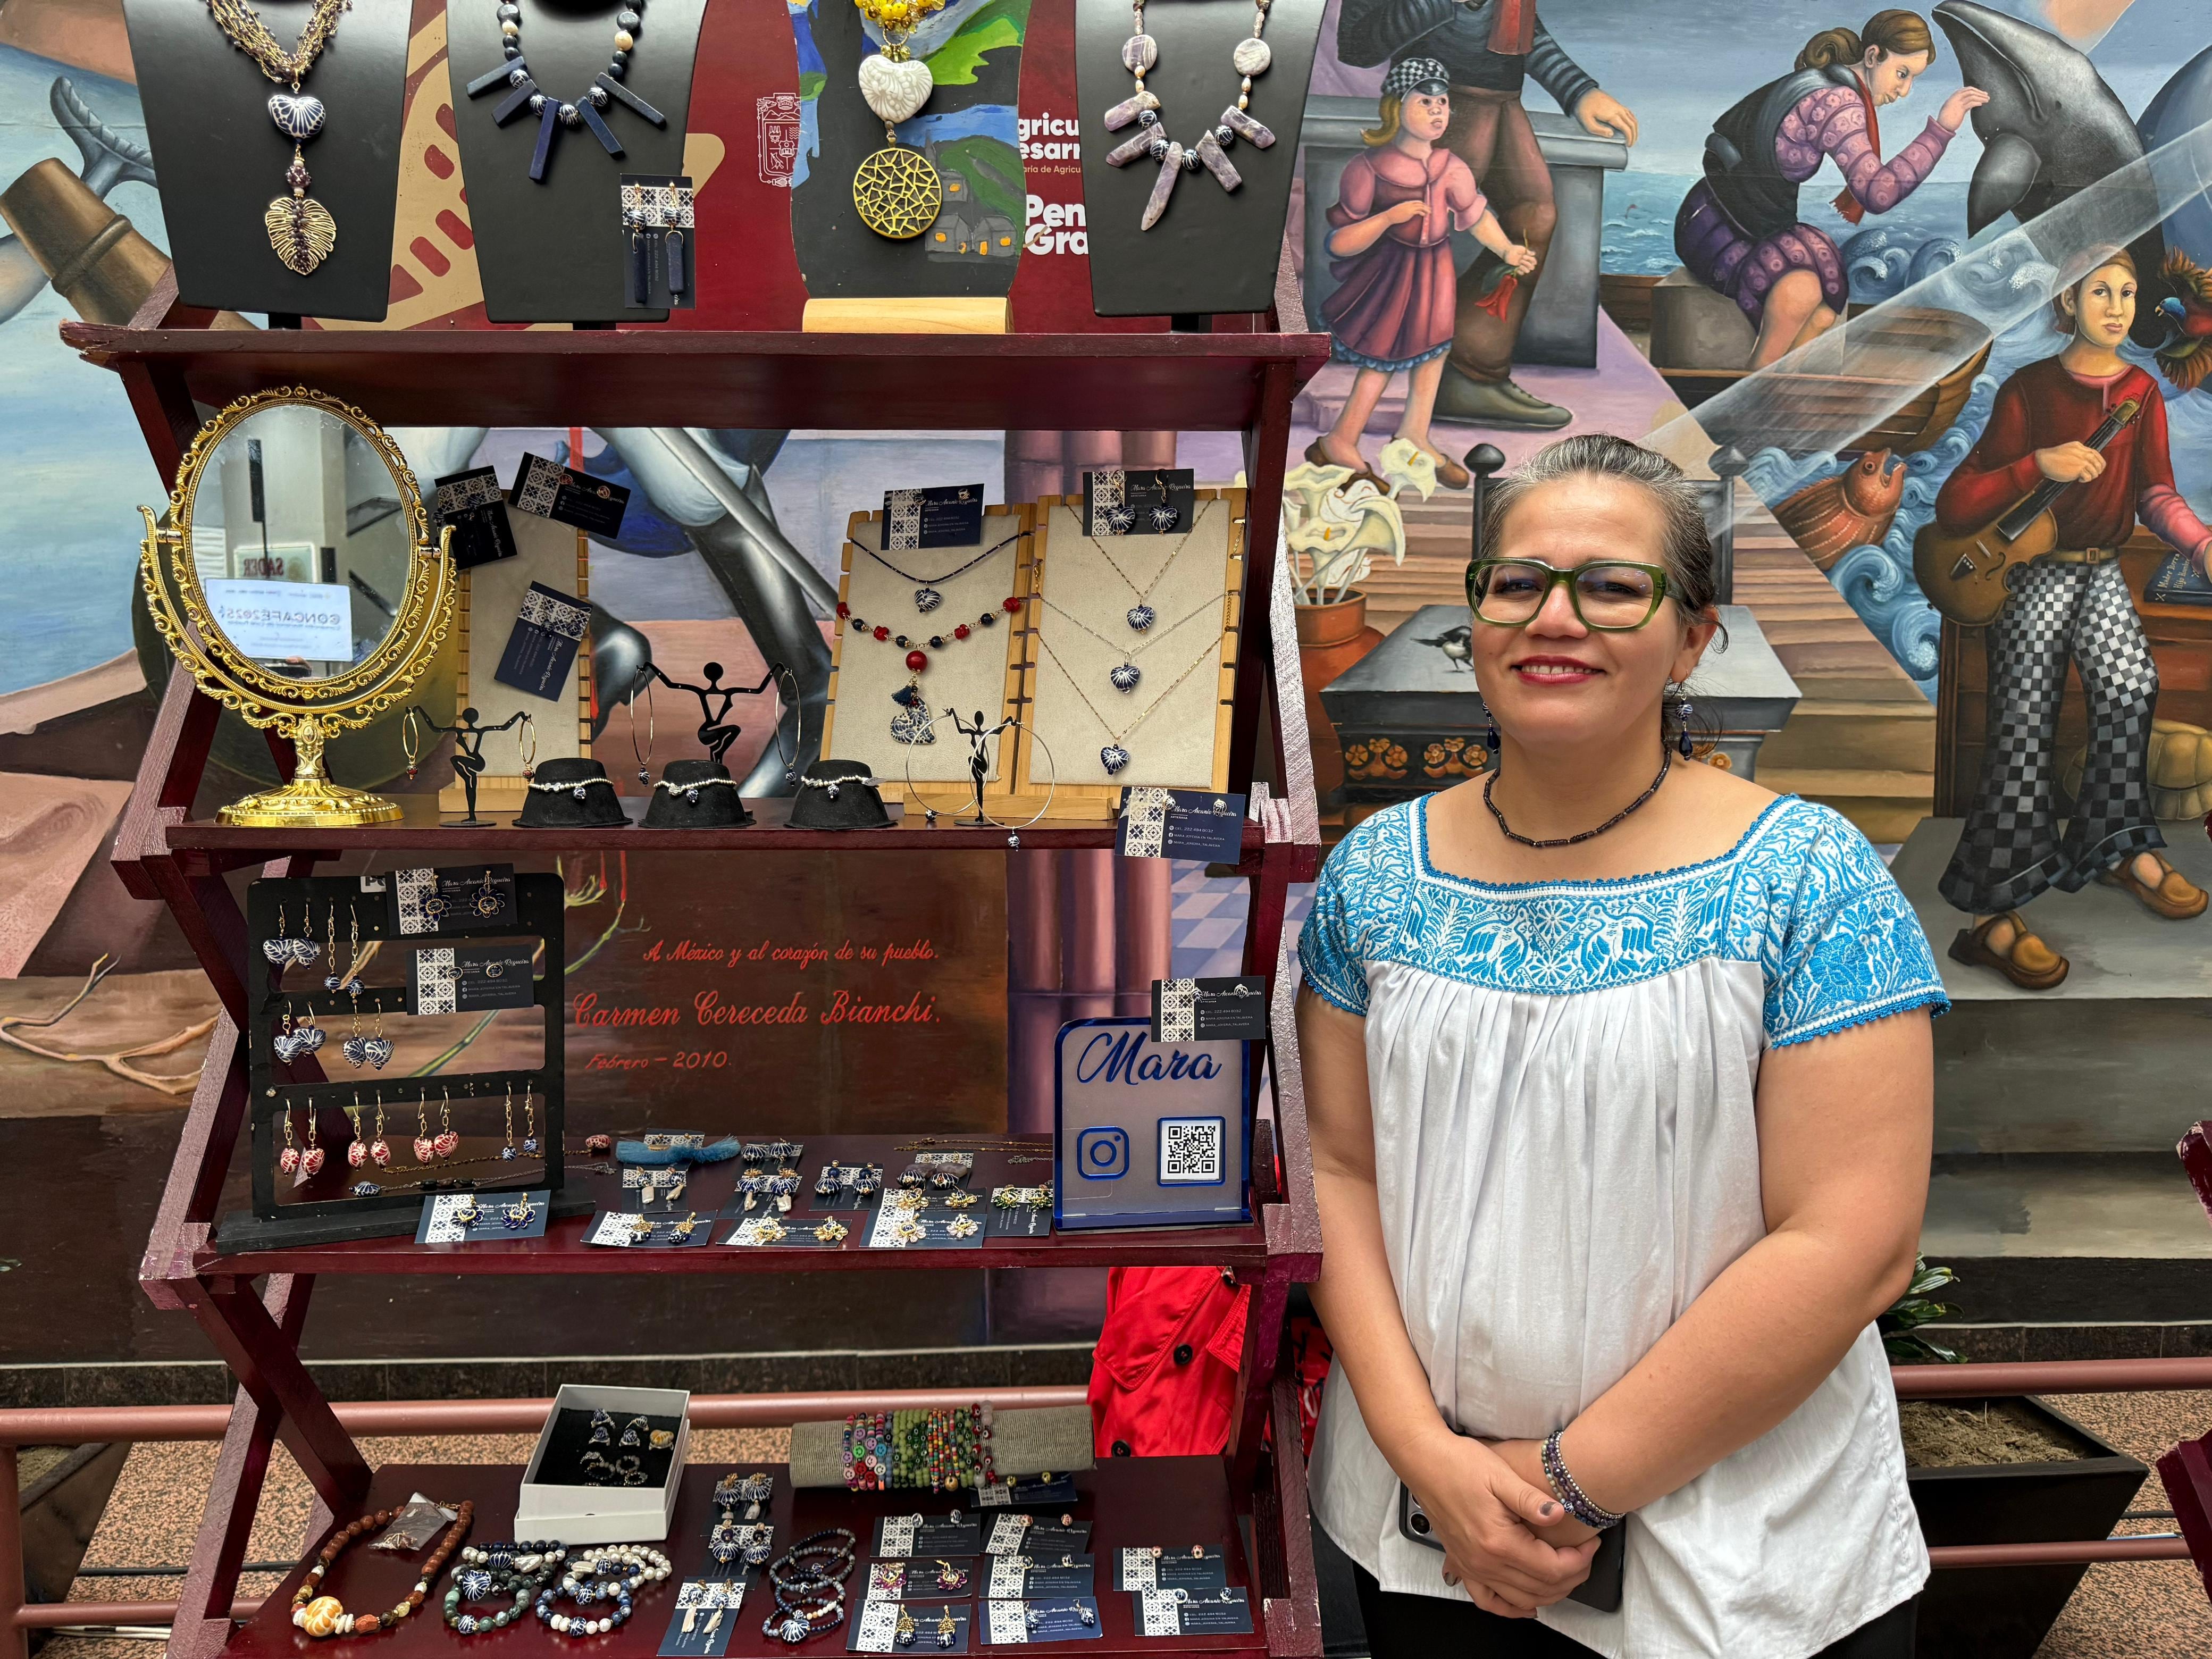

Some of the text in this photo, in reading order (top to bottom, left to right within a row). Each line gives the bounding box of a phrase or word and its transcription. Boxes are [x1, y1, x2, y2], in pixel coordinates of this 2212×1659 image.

[1053, 165, 1080, 175] Agricu
[1026, 195, 1086, 227] Pen
[1025, 223, 1088, 255] Gra
[643, 939, 939, 970] A México y al corazón de su pueblo.
[573, 990, 940, 1028] Carmen Cereceda Bianchi.
[585, 1053, 650, 1070] Febrero
[1076, 1030, 1222, 1085] Mara
